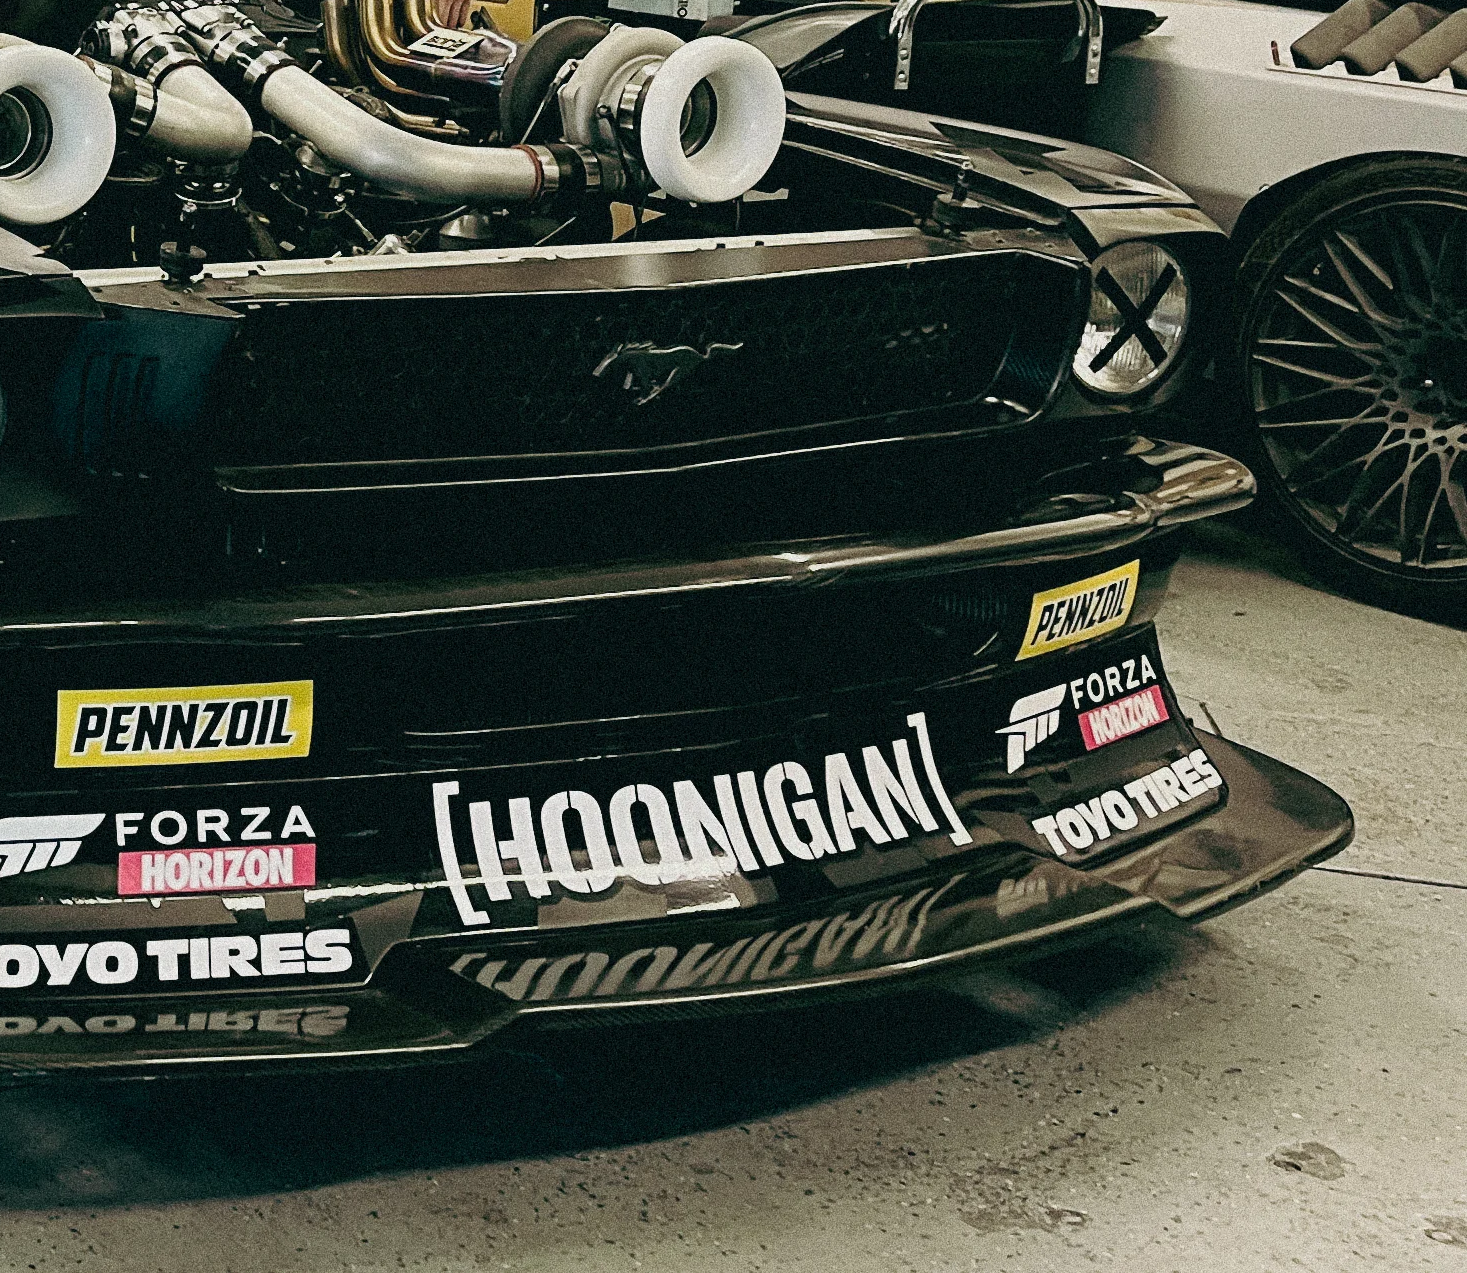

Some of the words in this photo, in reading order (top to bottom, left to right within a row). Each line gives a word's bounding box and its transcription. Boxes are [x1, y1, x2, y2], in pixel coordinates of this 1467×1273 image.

[1031, 577, 1130, 646] PENNZOIL
[1070, 654, 1158, 710] FORZA
[72, 697, 297, 755] PENNZOIL
[1087, 690, 1161, 746] HORIZON
[116, 805, 316, 846] FORZA
[1032, 789, 1139, 857] TOYO
[1123, 748, 1223, 819] TIRES
[140, 847, 295, 893] HORIZON
[146, 929, 354, 982] TIRES
